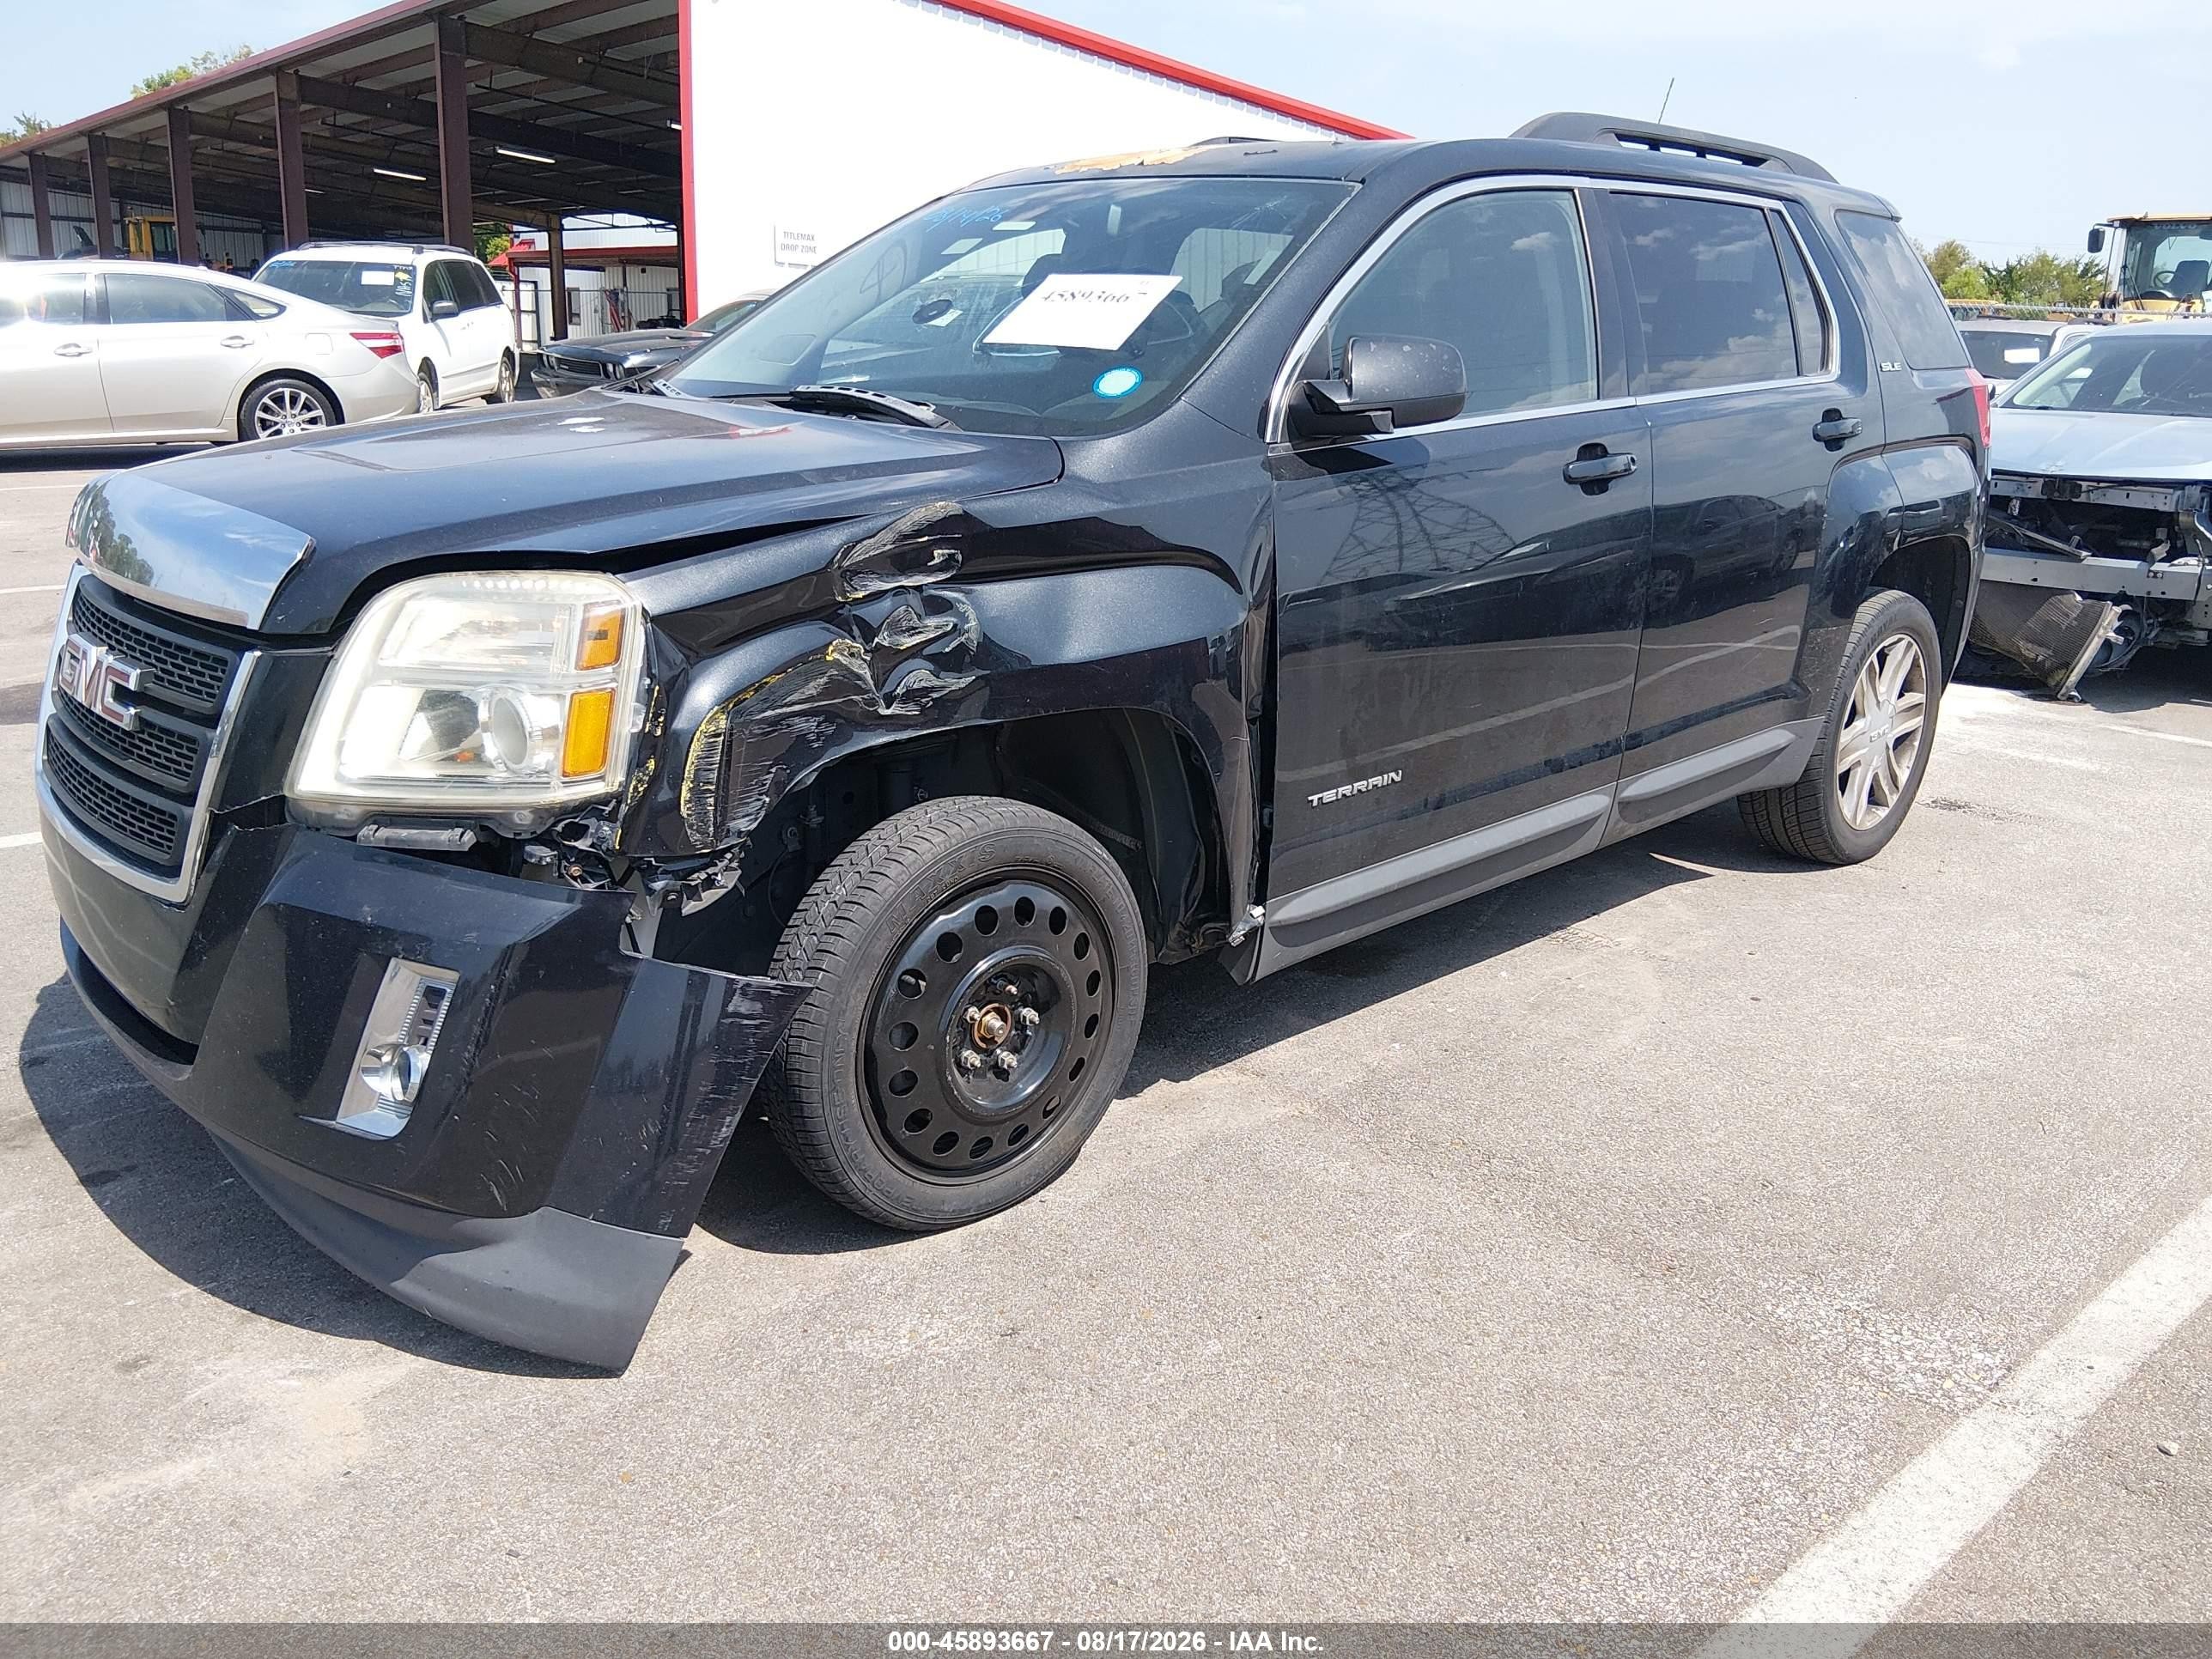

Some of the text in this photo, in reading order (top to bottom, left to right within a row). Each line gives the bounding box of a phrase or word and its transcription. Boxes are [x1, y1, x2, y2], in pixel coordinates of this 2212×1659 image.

[783, 231, 816, 241] TITLEMAX
[781, 242, 799, 252] DROP
[1881, 362, 1903, 372] SLE
[58, 633, 148, 732] GMC
[1307, 769, 1402, 808] TERRAIN
